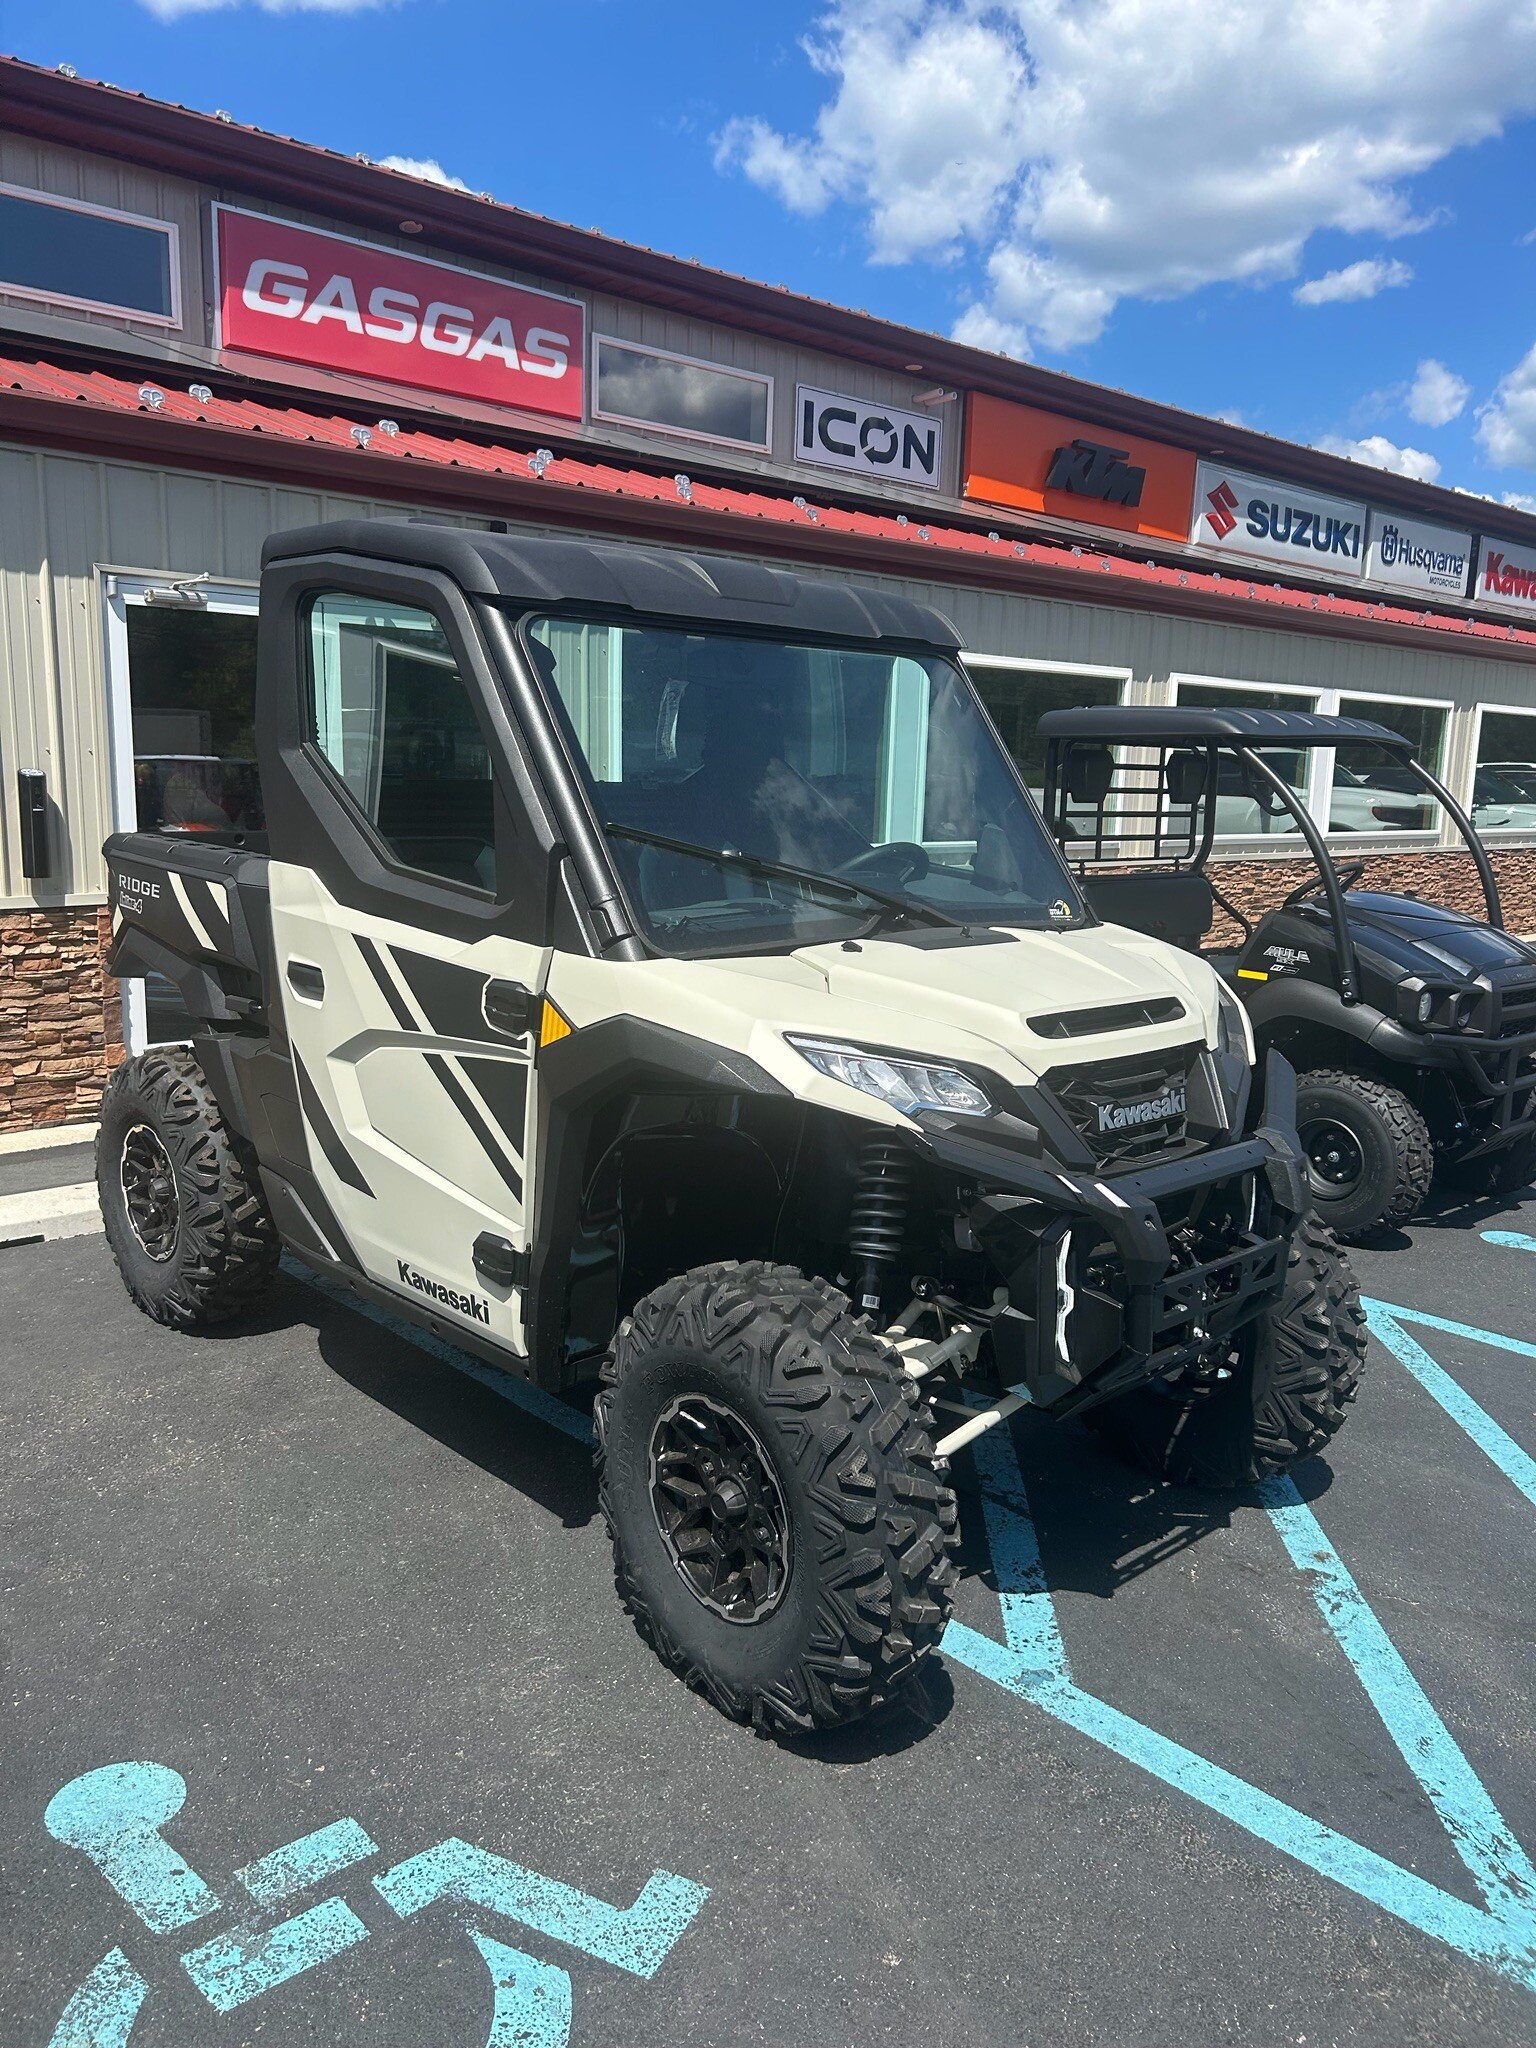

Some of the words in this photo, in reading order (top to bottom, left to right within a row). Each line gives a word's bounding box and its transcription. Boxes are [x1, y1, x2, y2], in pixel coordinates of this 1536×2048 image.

[242, 258, 571, 380] GASGAS
[802, 399, 936, 475] ICON
[1045, 439, 1147, 508] KTM
[1246, 499, 1361, 559] SUZUKI
[1398, 537, 1464, 576] Husqvarna
[1428, 576, 1461, 590] MOTORCYCLES
[119, 873, 161, 899] RIDGE
[1263, 945, 1311, 963] MULE
[1098, 1087, 1187, 1132] Kawasaki
[397, 1259, 491, 1326] Kawasaki
